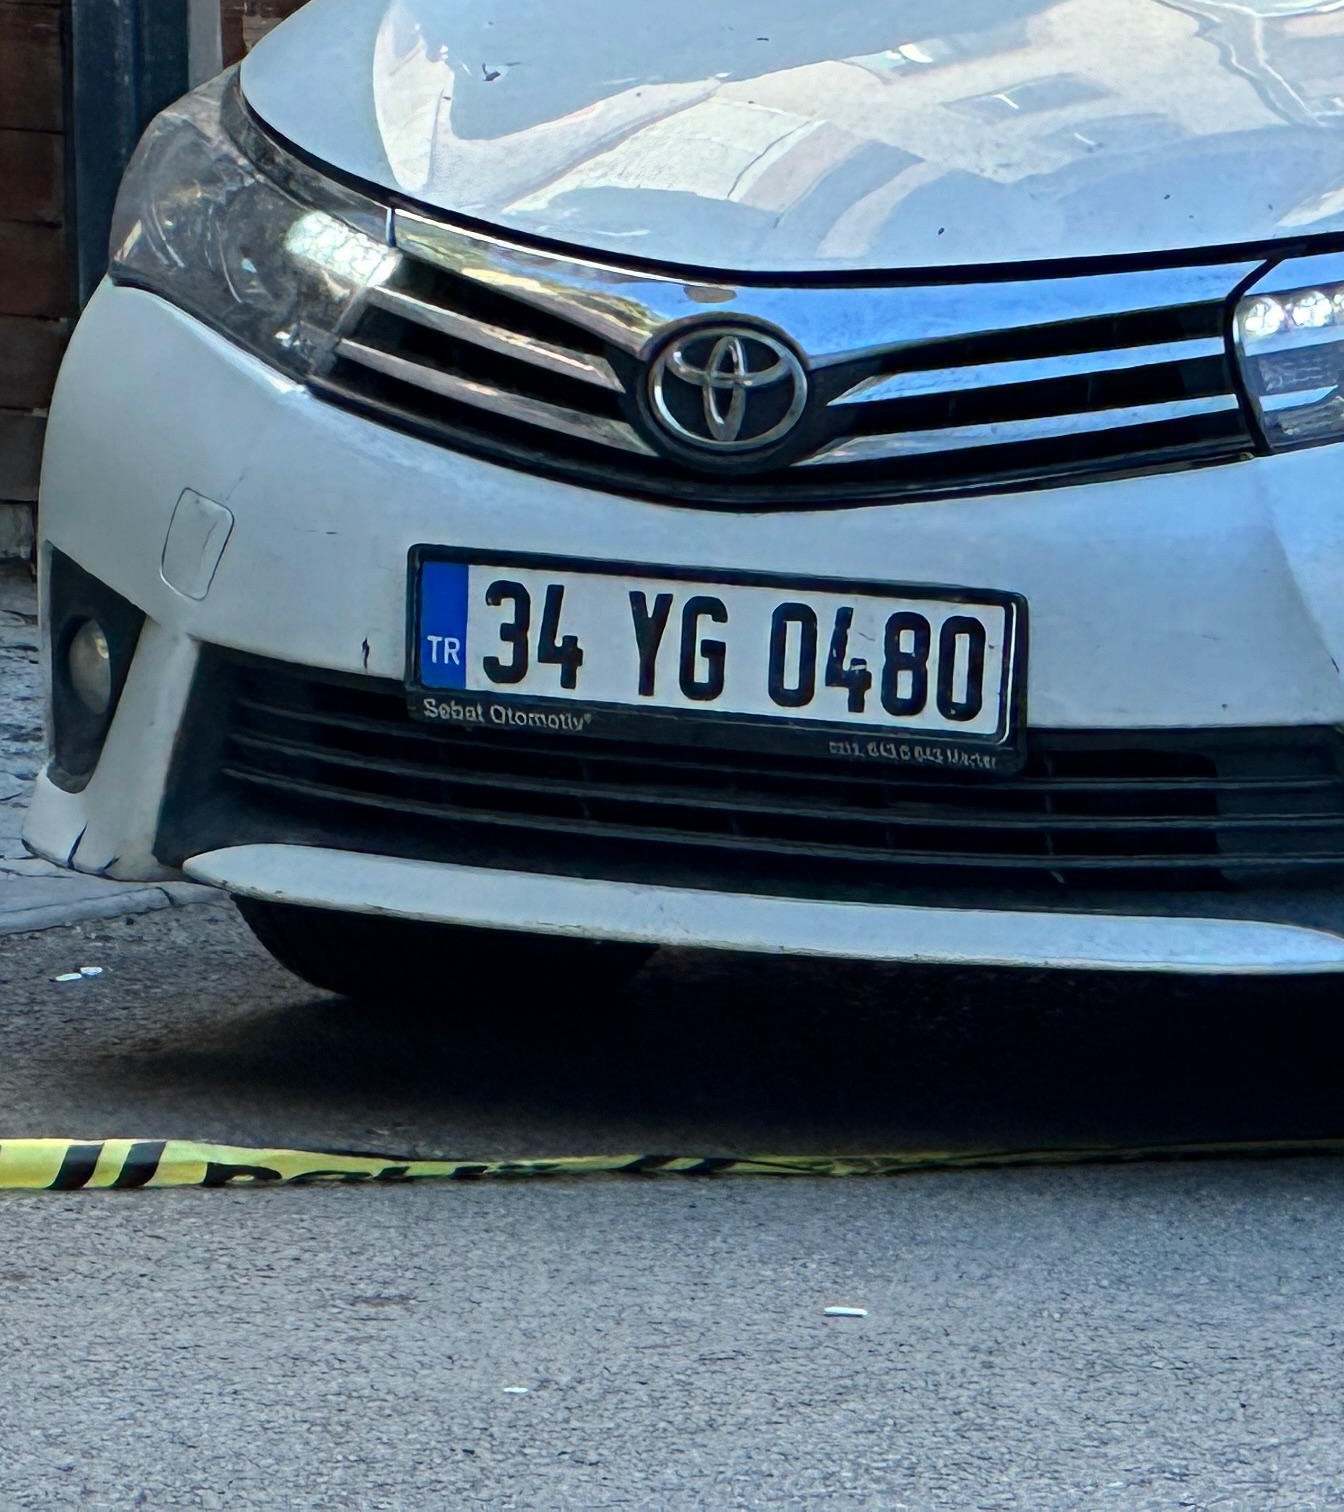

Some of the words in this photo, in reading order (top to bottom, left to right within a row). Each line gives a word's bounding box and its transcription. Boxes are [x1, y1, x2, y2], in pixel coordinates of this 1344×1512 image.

[426, 634, 461, 666] TR
[482, 579, 584, 690] 34
[628, 590, 728, 702] YG
[768, 602, 987, 722] 0480
[422, 698, 483, 724] Sebat
